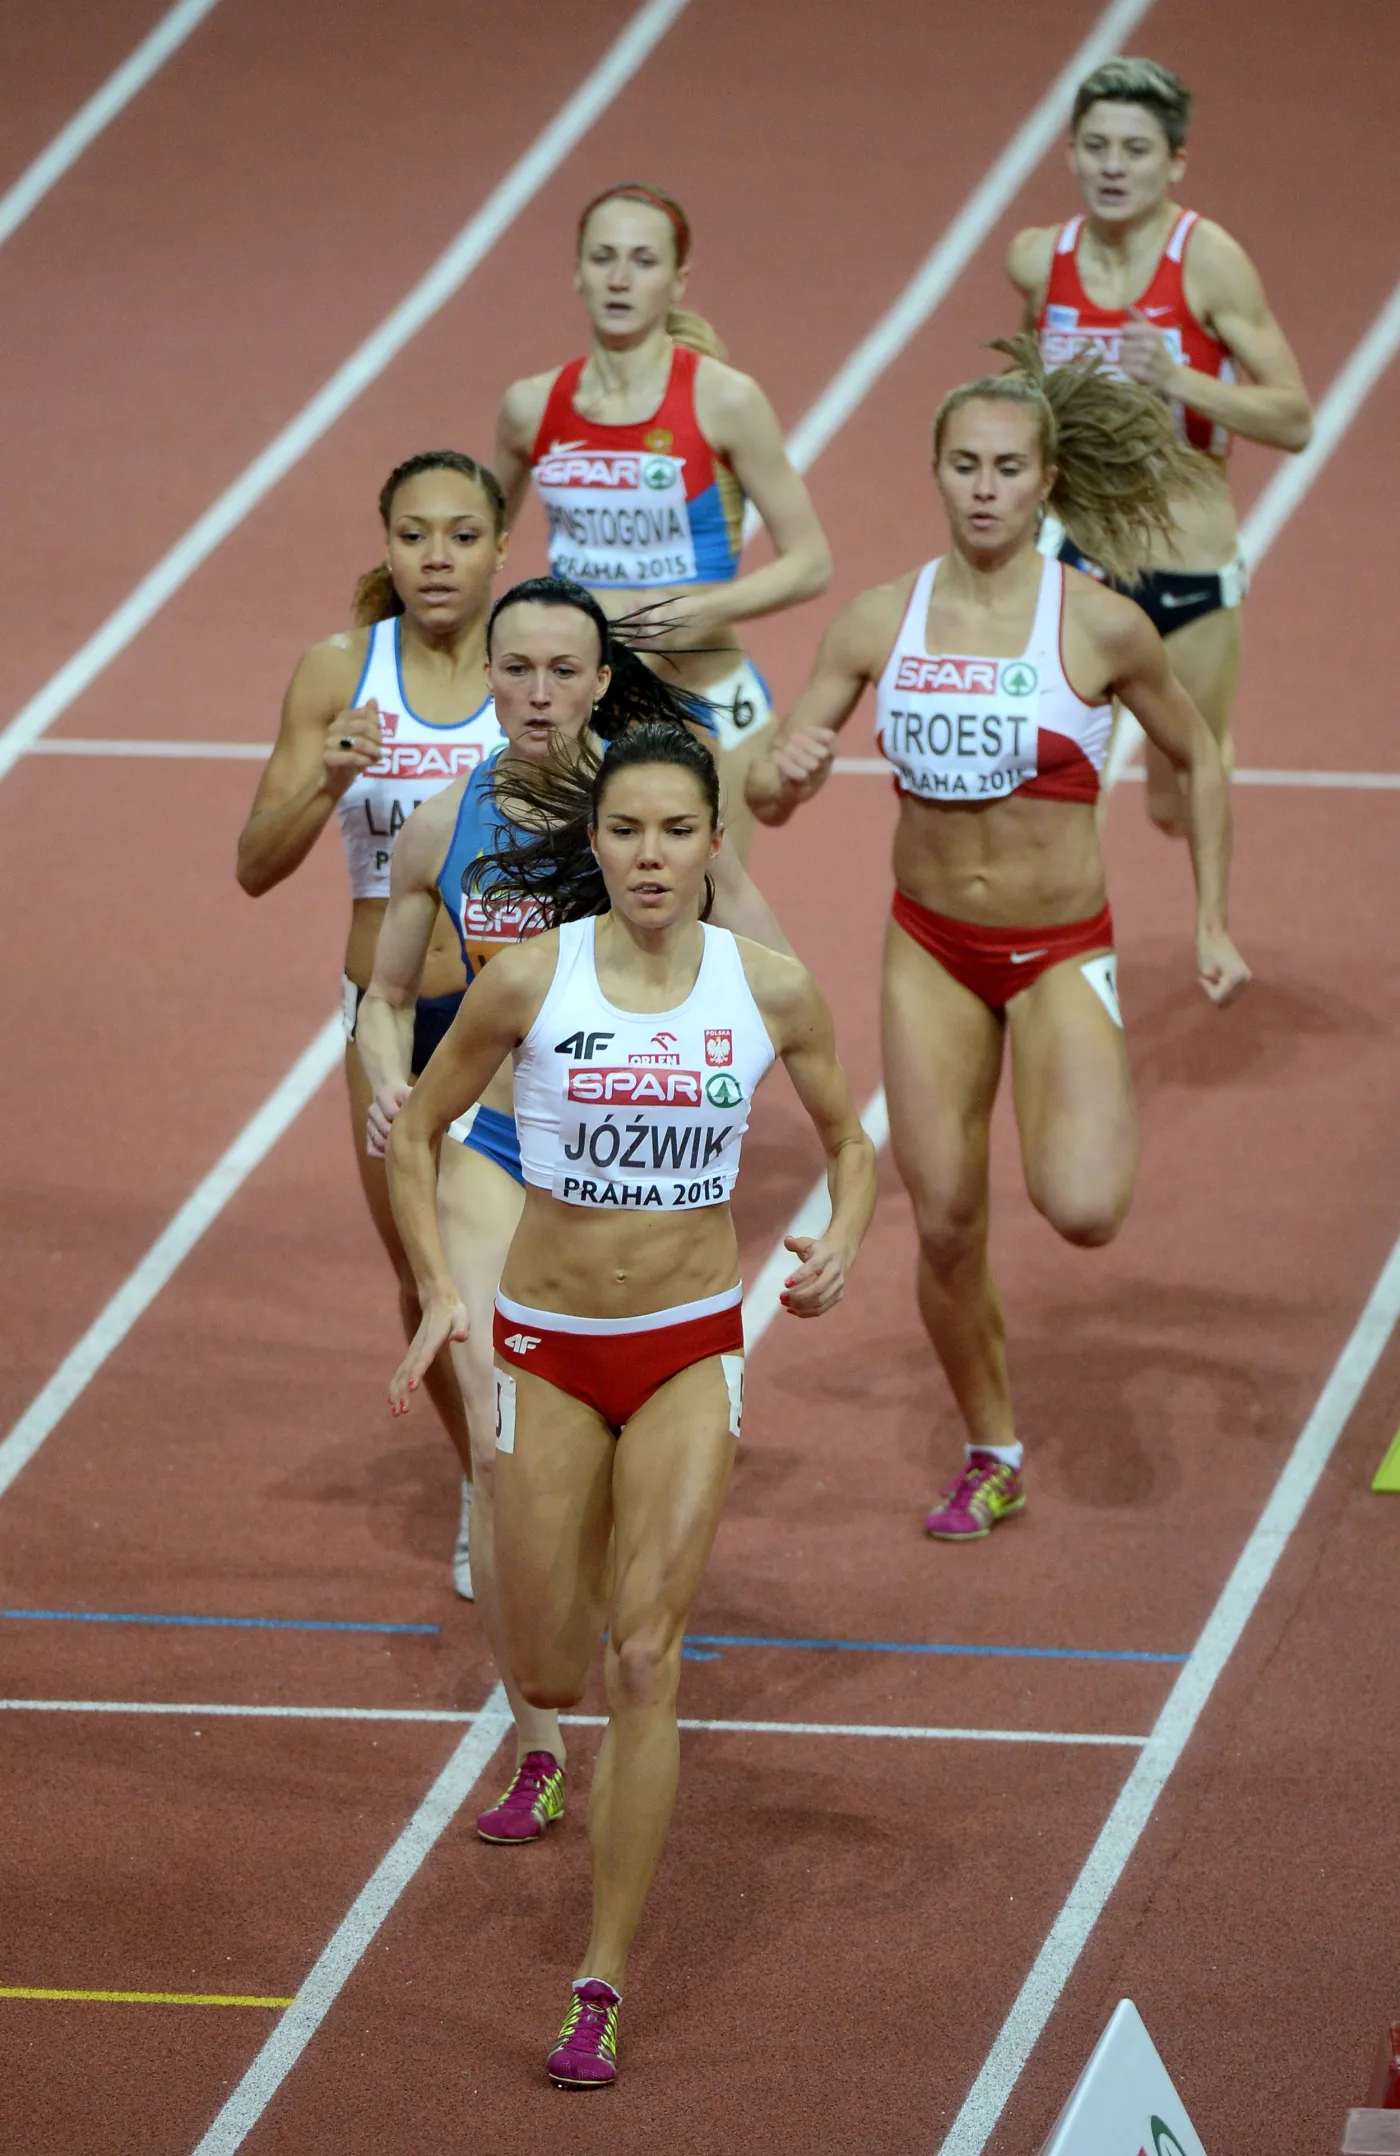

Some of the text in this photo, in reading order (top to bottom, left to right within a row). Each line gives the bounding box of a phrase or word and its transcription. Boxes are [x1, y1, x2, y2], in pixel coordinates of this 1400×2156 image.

[636, 556, 687, 580] 2015
[733, 683, 754, 729] 6
[890, 710, 1029, 758] TROEST
[366, 747, 481, 775] SPAR
[467, 900, 558, 932] SPA
[554, 1031, 616, 1060] 4F
[705, 1029, 731, 1037] POLSKA
[629, 1054, 678, 1066] ORLEN
[570, 1072, 699, 1103] SPAR
[564, 1113, 734, 1170] JÓŹWIK
[563, 1175, 725, 1207] PRAHA 2015
[504, 1333, 542, 1355] 4F
